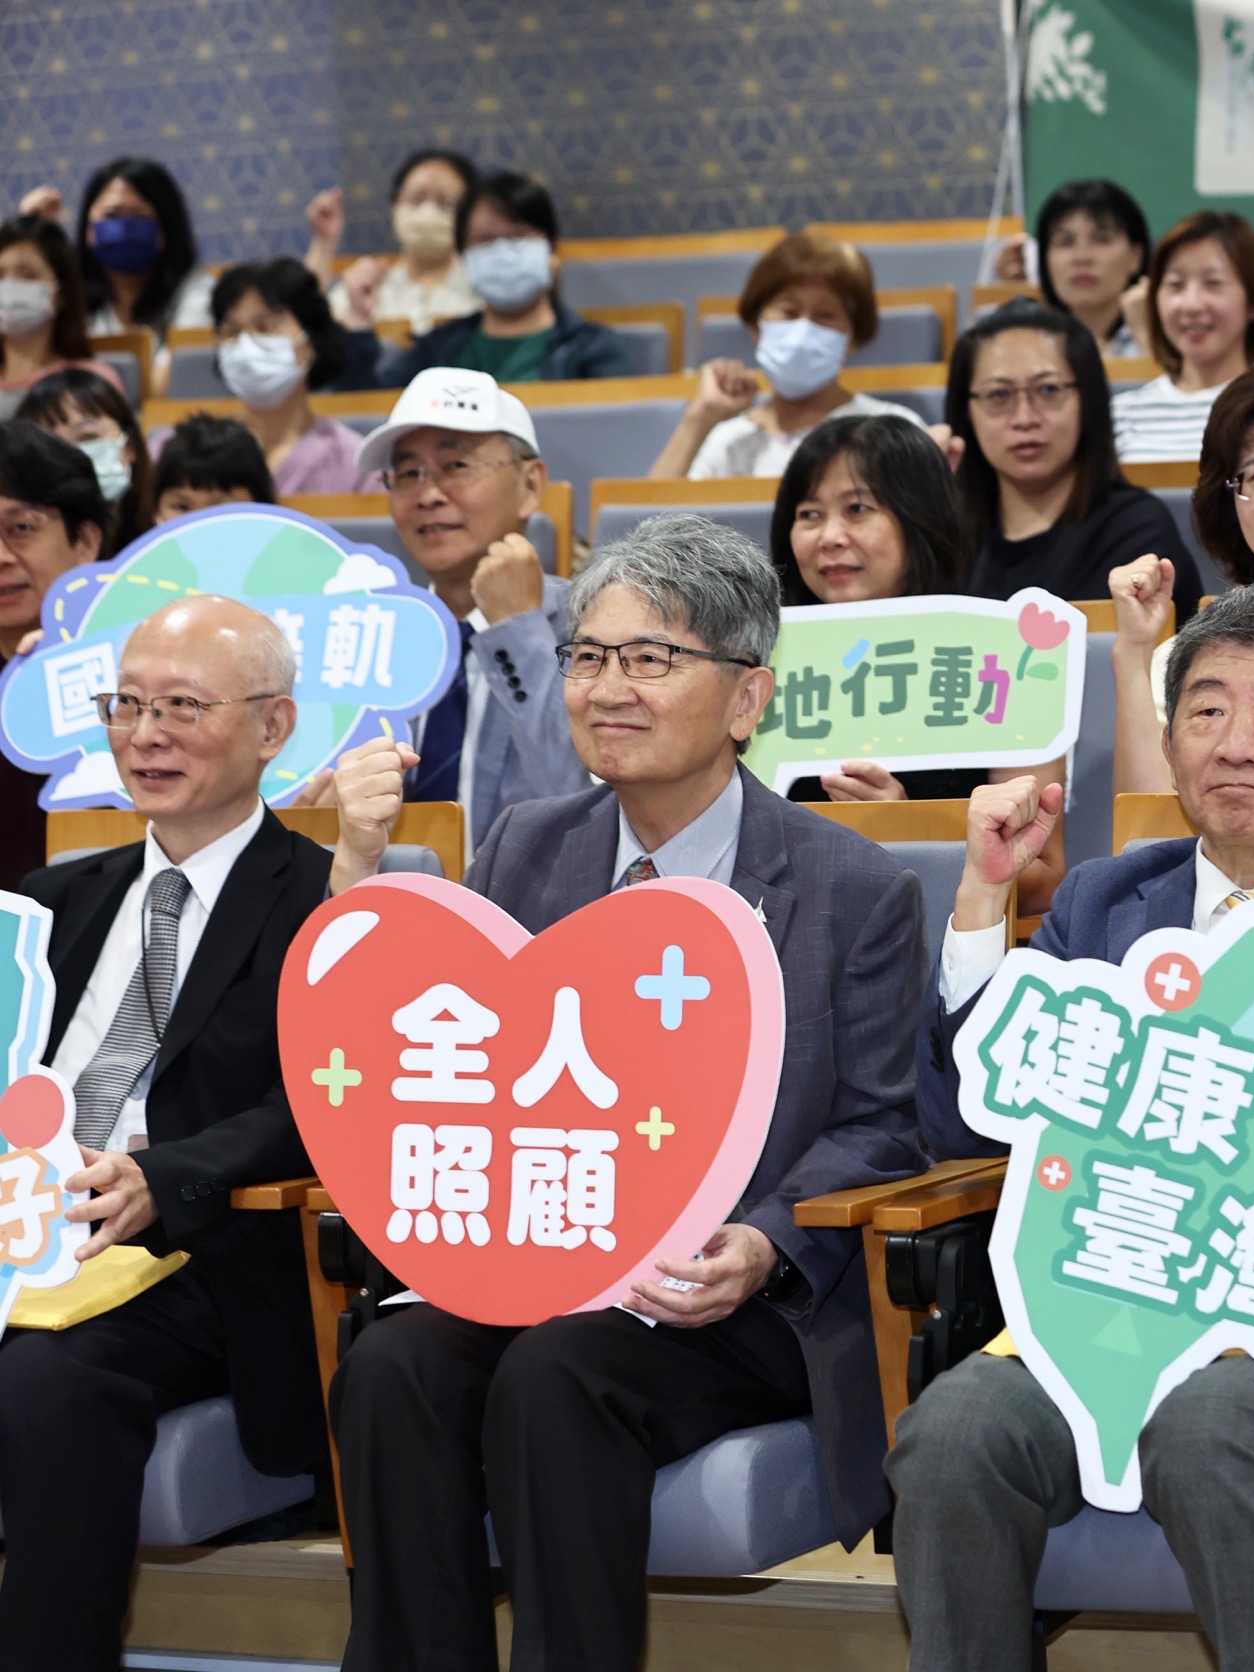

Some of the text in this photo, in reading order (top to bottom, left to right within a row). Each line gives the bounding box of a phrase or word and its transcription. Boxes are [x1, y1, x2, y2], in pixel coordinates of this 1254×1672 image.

[44, 604, 397, 737] 國軌
[391, 983, 619, 1109] 全人
[386, 1123, 619, 1252] 照顧
